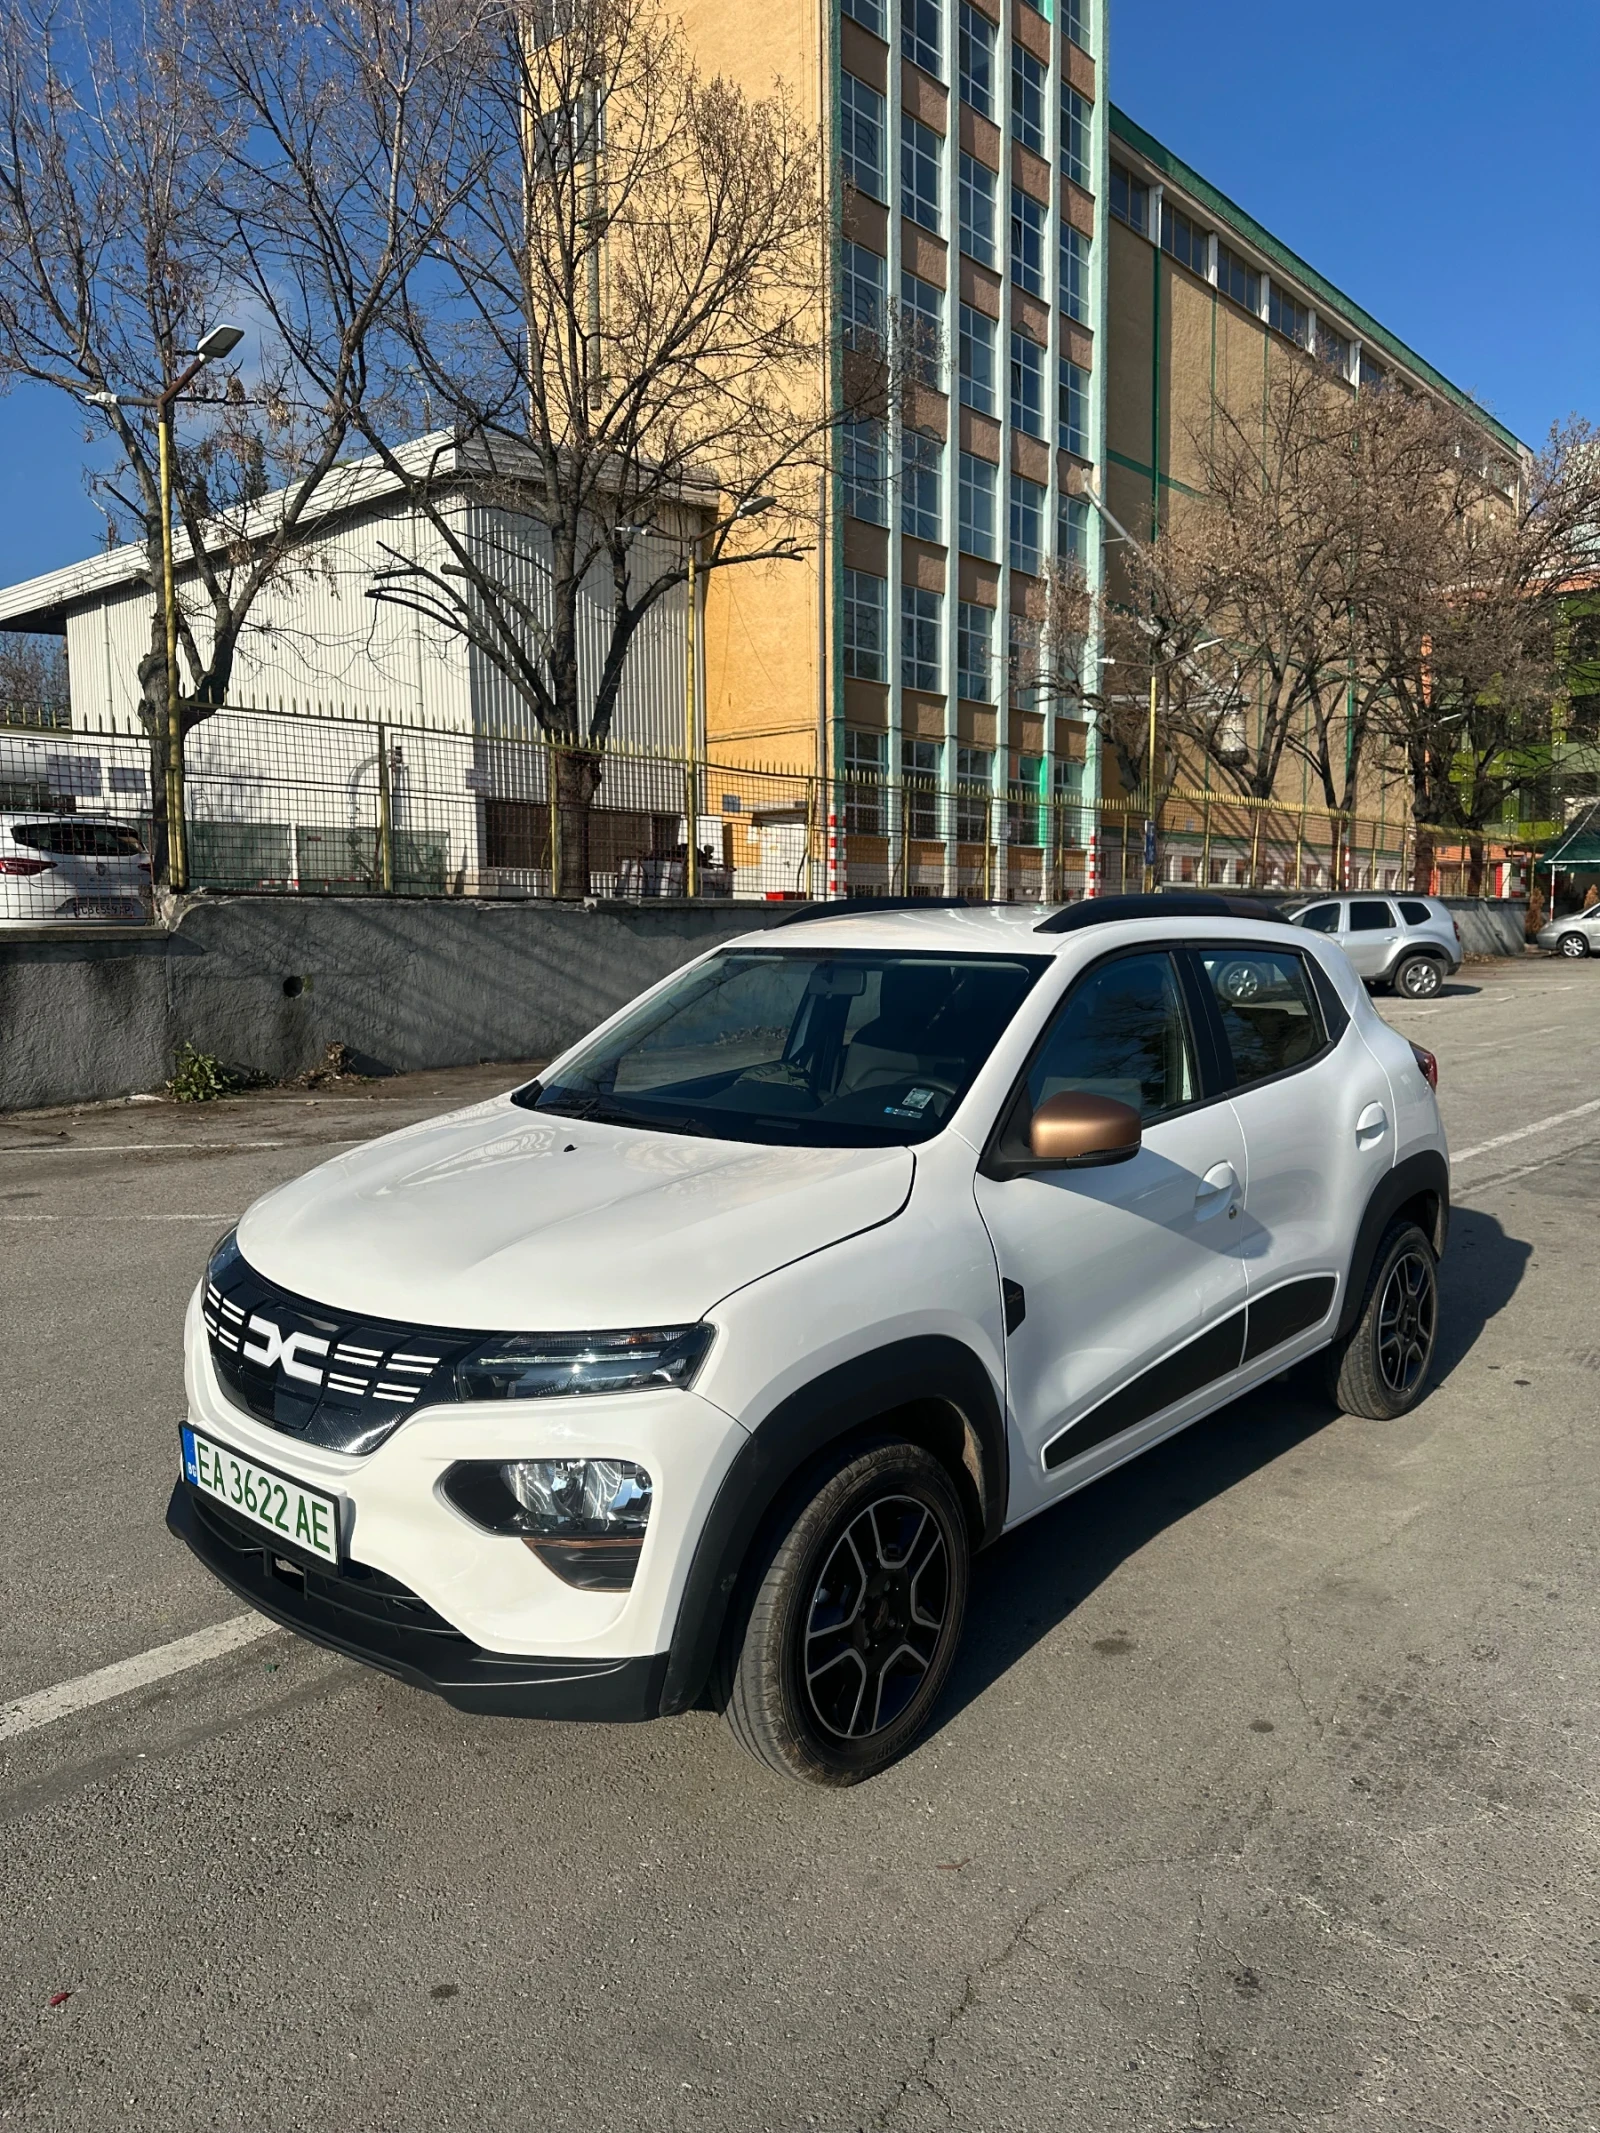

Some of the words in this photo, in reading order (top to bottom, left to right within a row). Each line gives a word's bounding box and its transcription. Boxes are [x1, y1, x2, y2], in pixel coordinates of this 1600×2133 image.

[188, 1462, 197, 1477] BG
[197, 1441, 226, 1496] EA
[230, 1461, 290, 1532] 3622
[295, 1495, 331, 1554] AE
